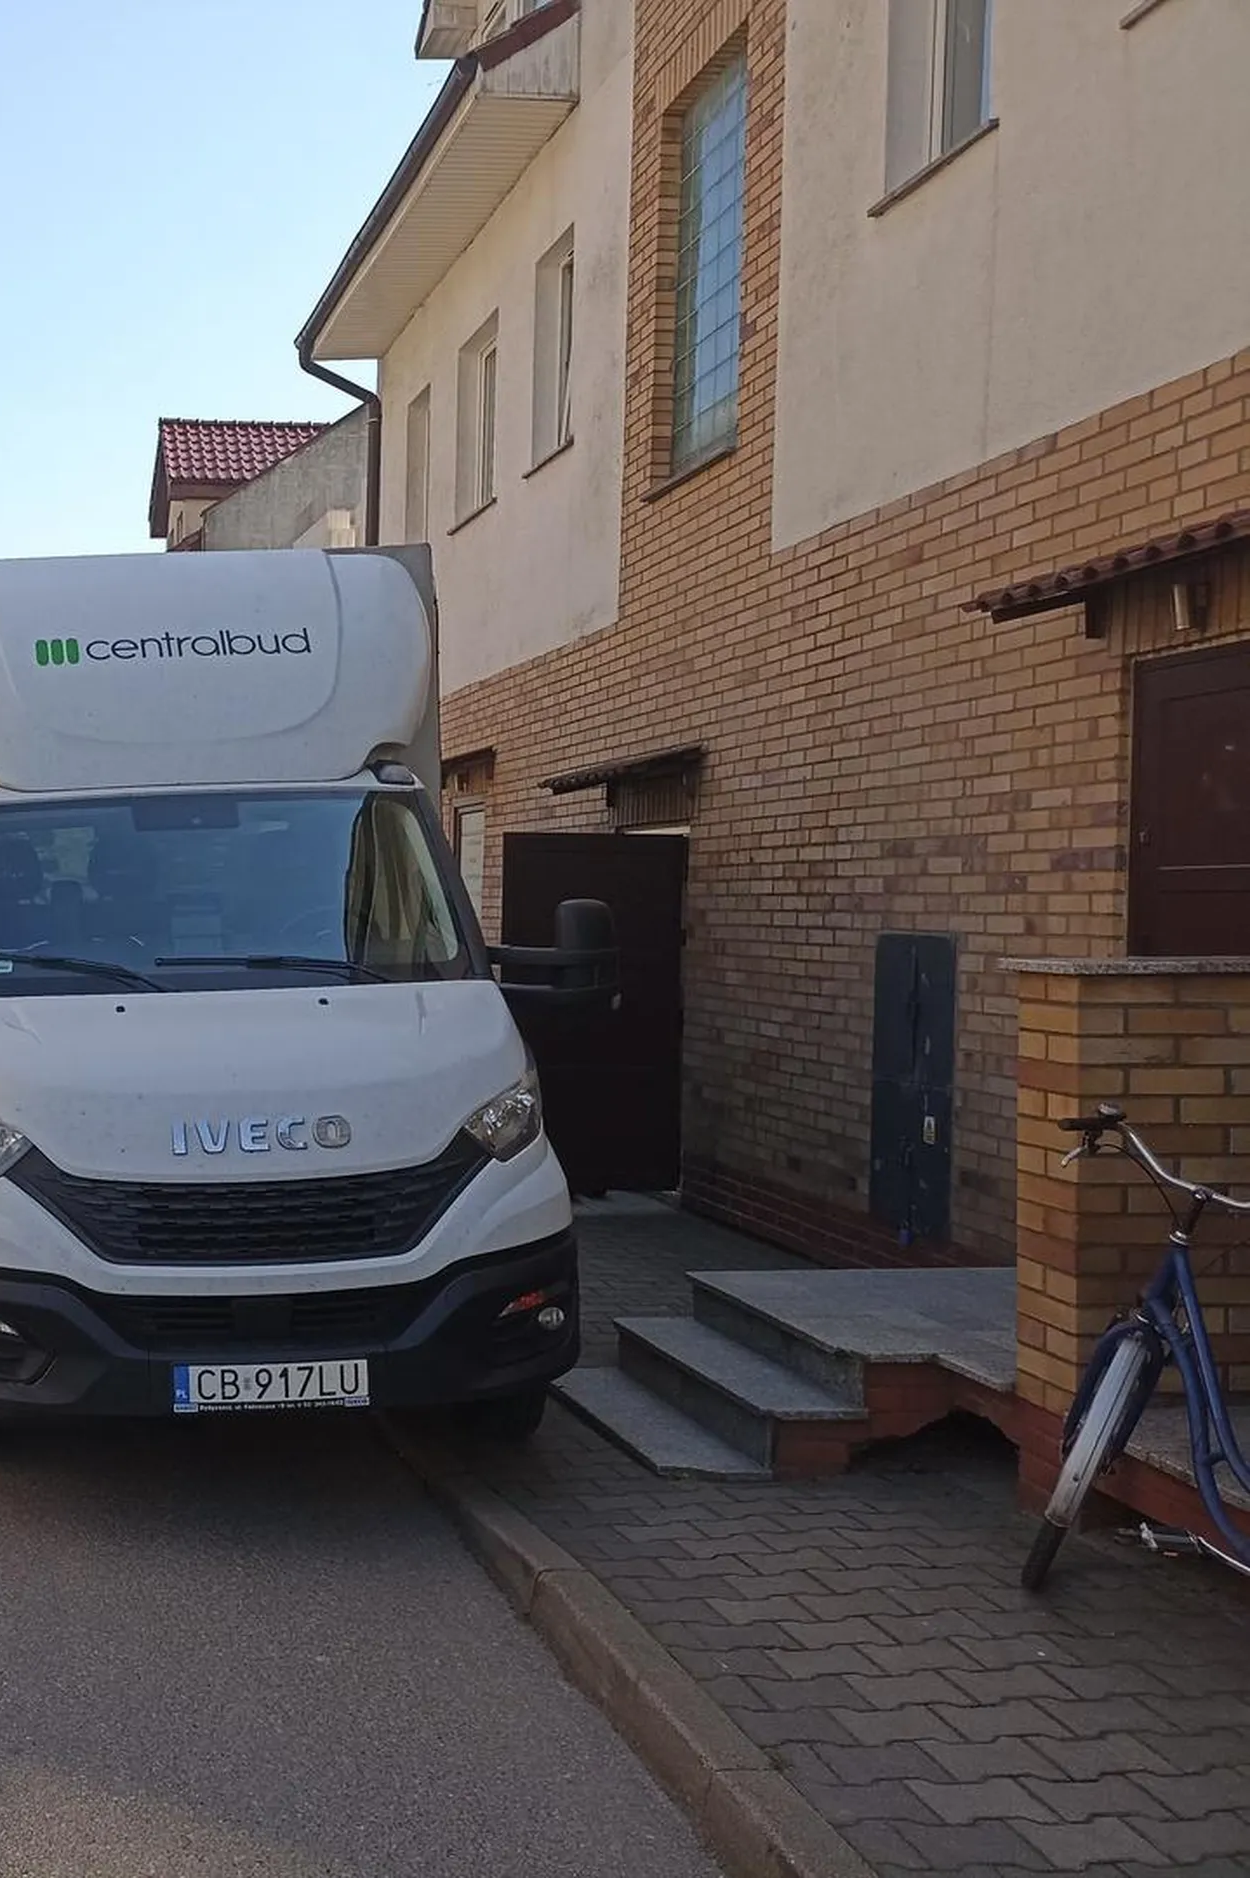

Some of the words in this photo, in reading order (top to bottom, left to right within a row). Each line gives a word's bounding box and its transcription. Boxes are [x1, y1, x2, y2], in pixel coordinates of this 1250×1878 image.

[86, 627, 312, 661] centralbud
[171, 1112, 352, 1156] IVECO
[176, 1388, 188, 1399] PL
[197, 1368, 240, 1400] CB
[254, 1363, 360, 1399] 917LU
